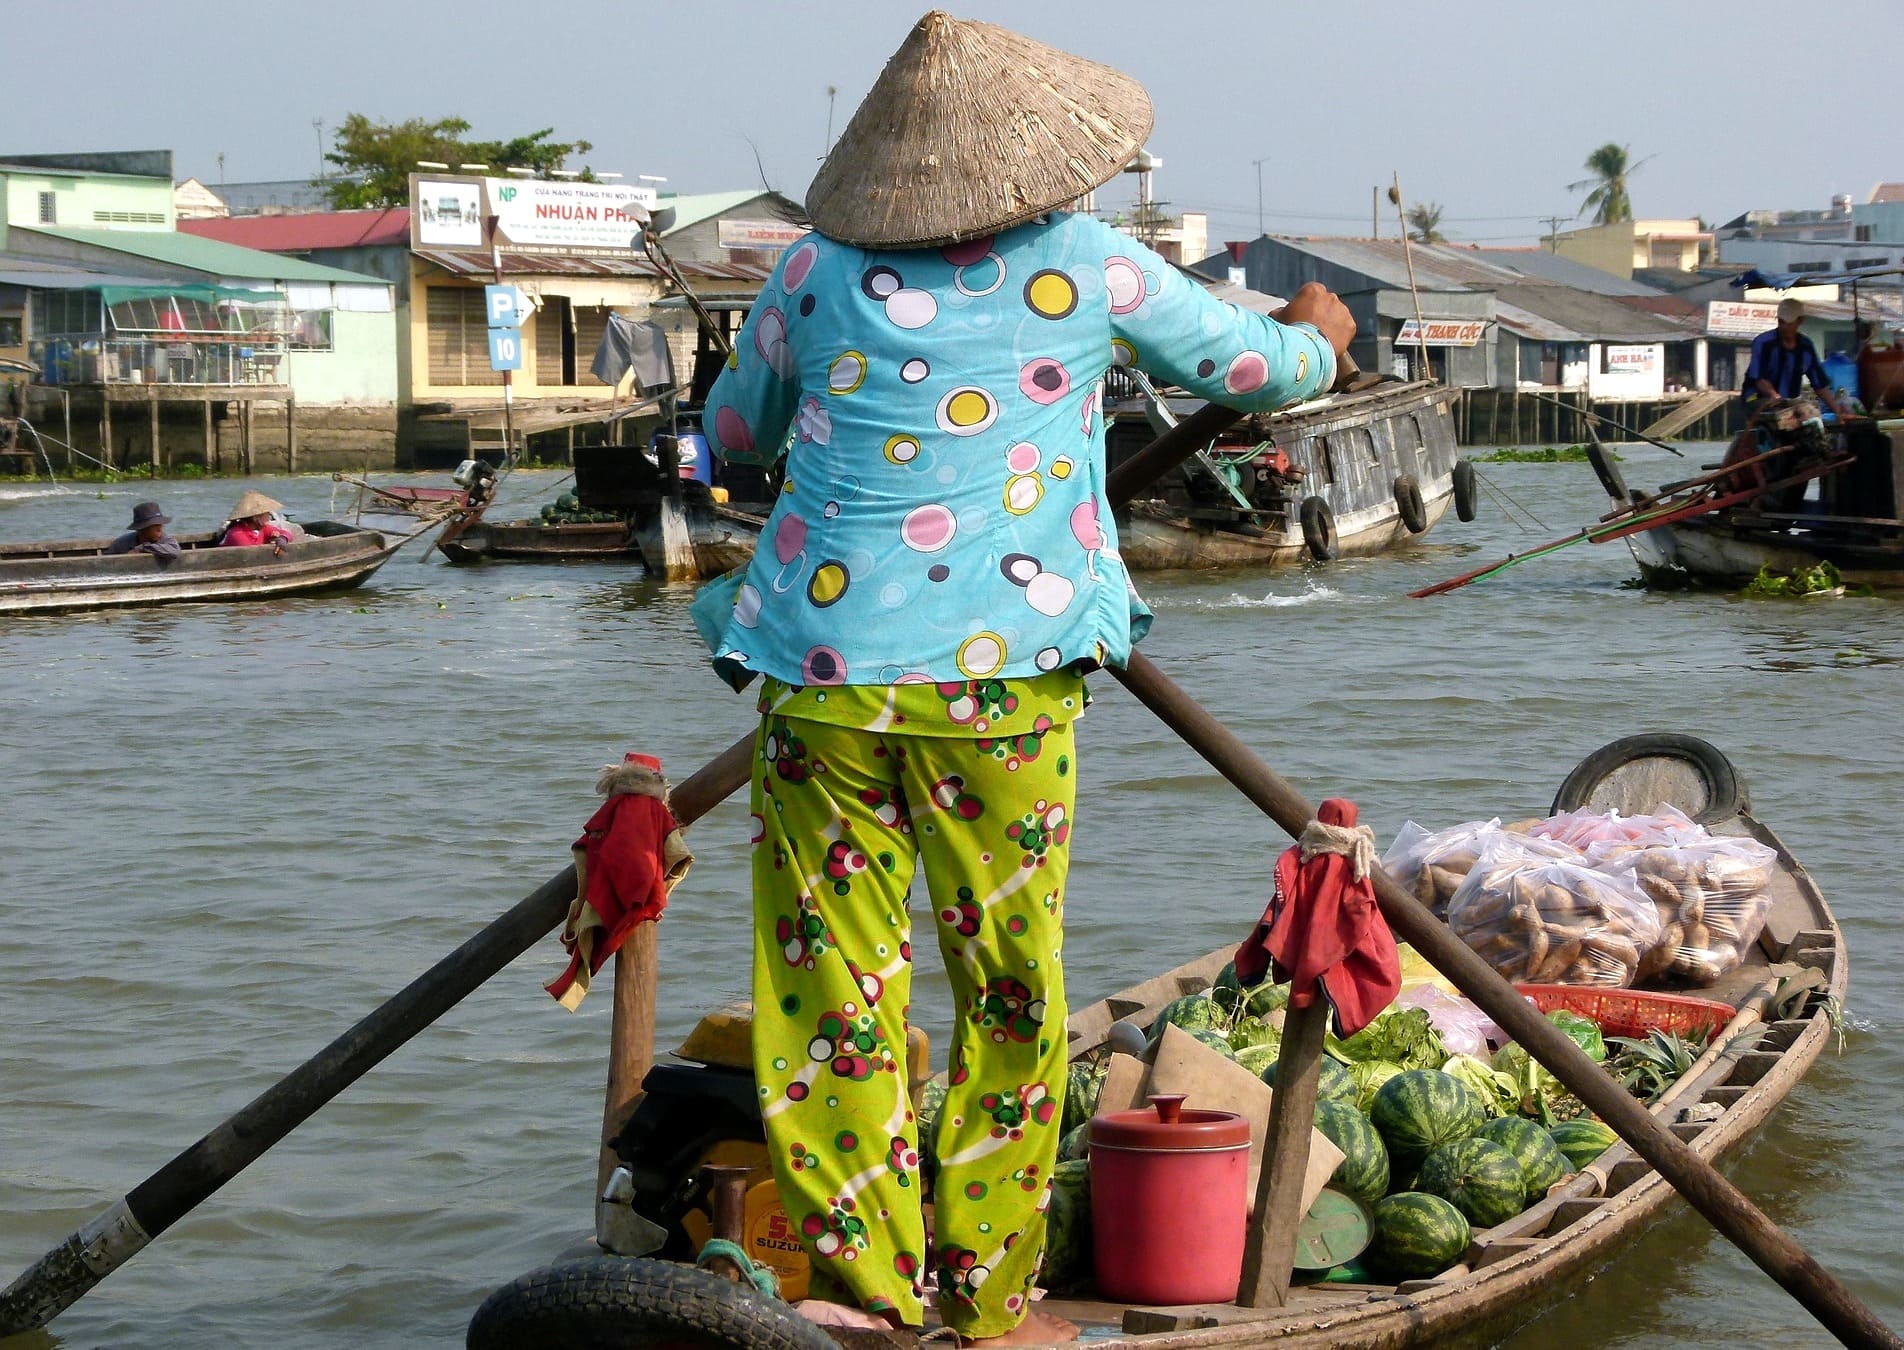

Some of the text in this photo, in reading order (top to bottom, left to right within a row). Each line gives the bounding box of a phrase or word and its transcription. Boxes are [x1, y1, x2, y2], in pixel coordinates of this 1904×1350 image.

[499, 186, 517, 202] NP
[492, 292, 512, 320] P
[496, 339, 515, 360] 10
